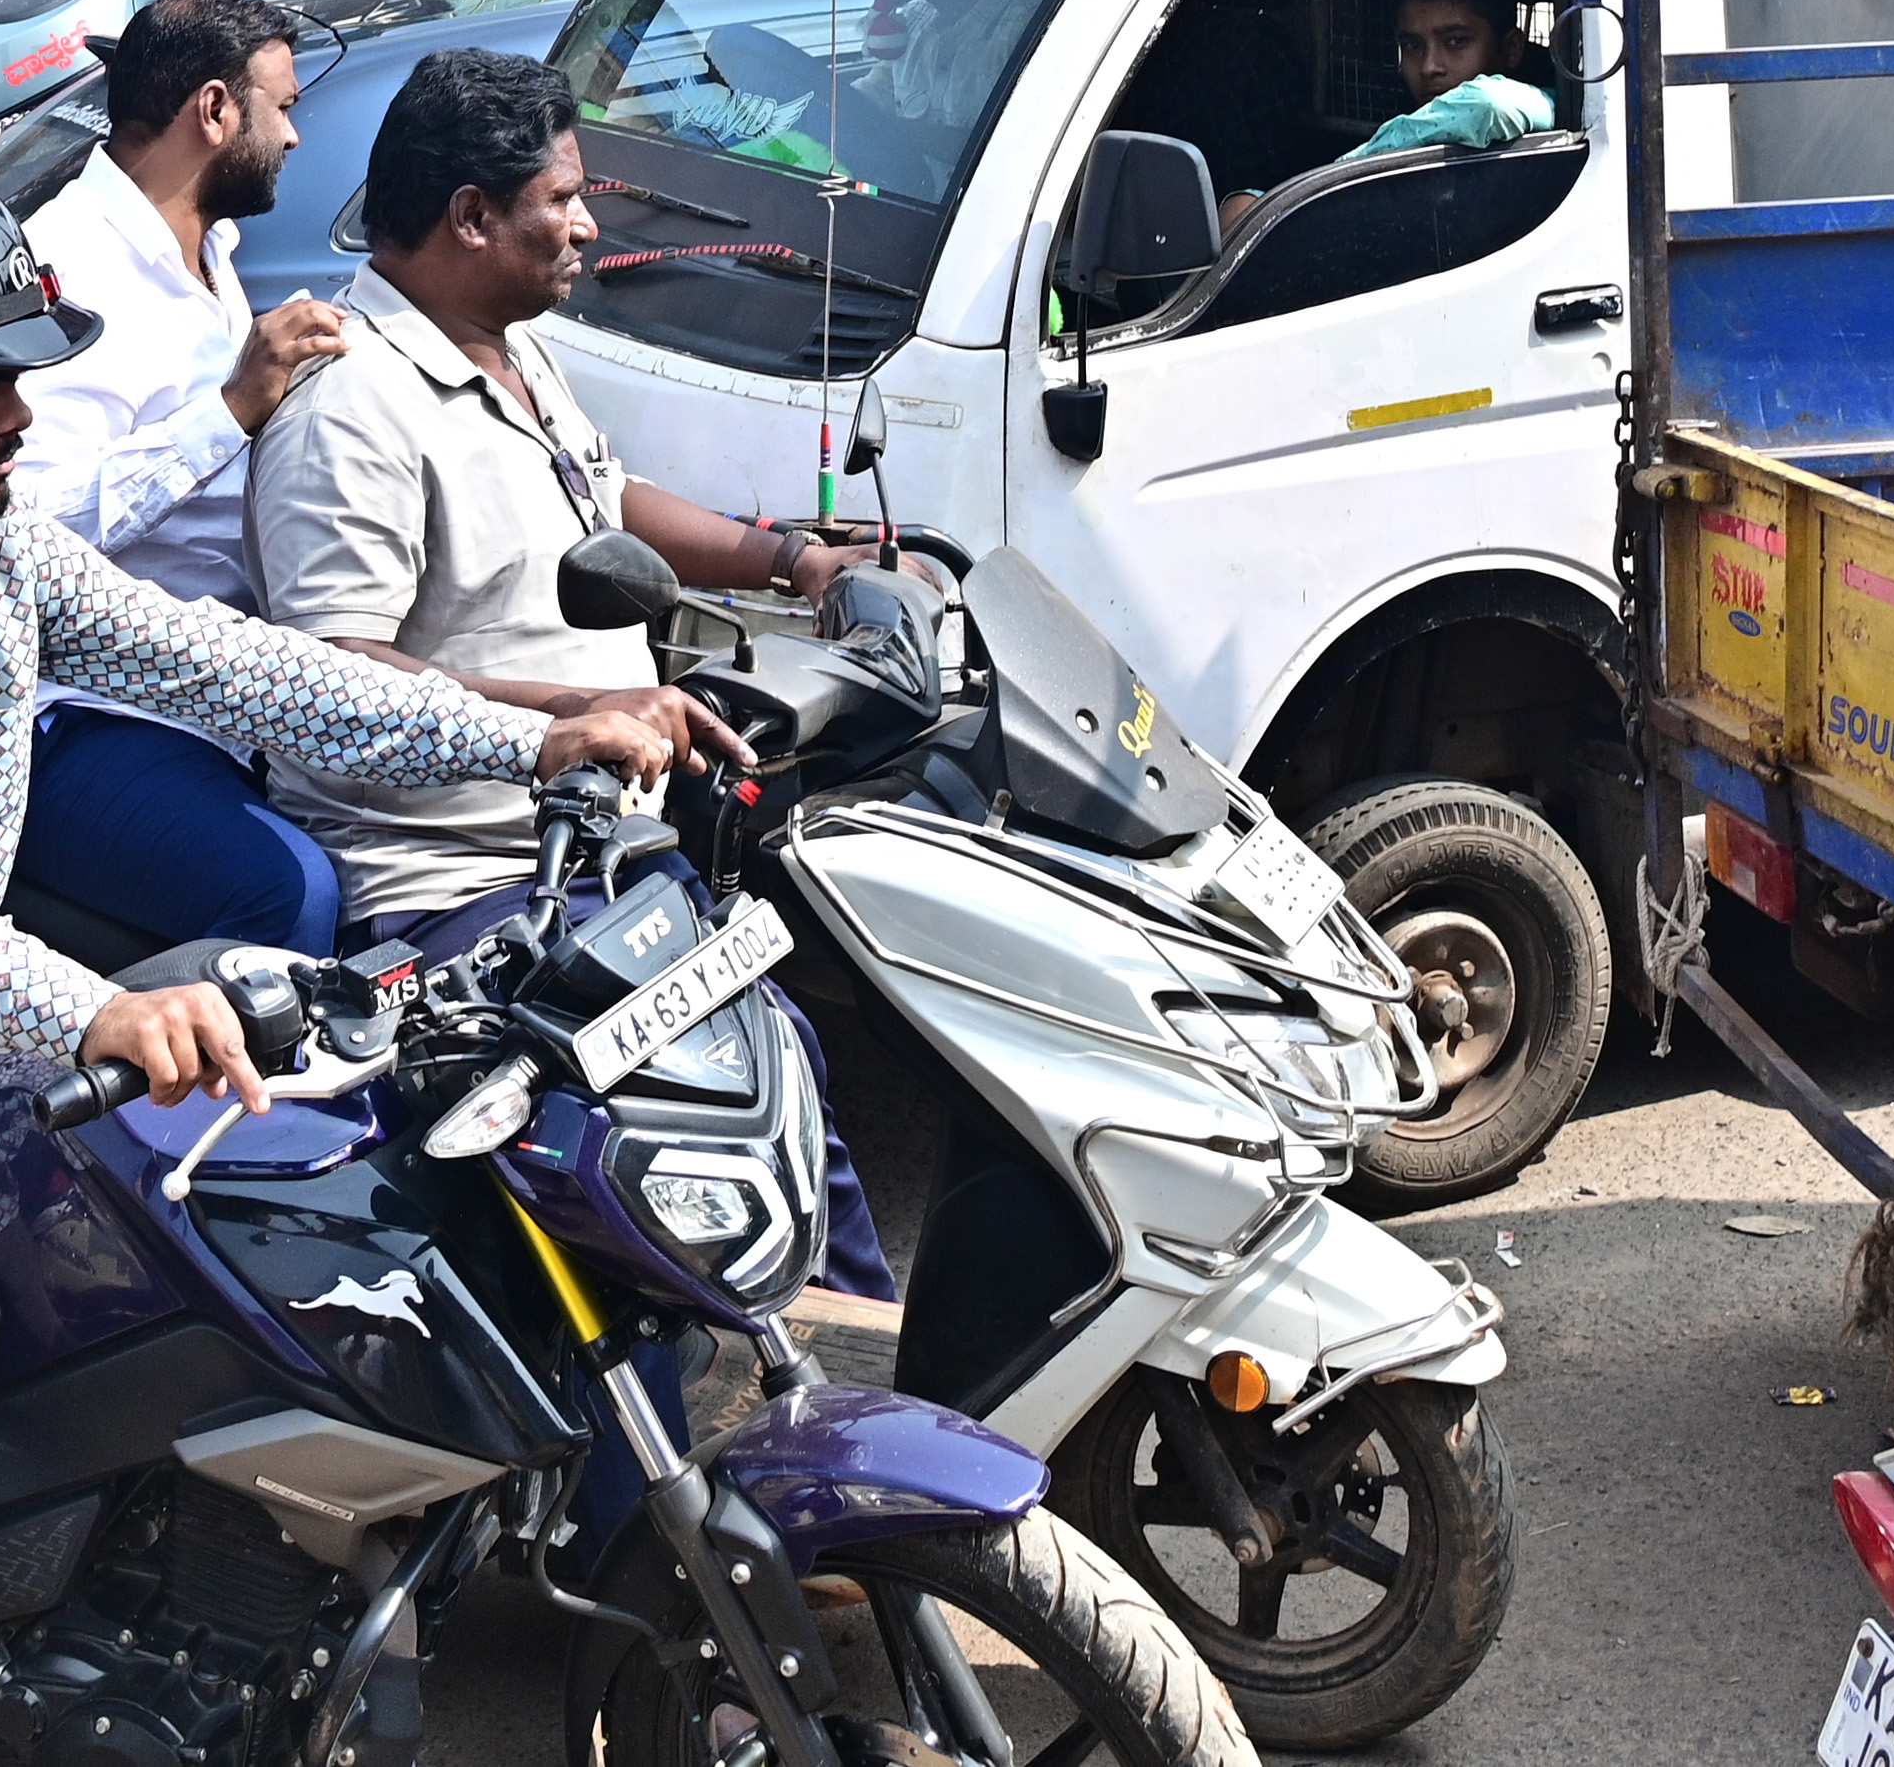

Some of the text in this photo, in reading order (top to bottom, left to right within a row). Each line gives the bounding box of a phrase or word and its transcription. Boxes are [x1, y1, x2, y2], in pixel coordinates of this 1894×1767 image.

[1712, 551, 1765, 616] STOP
[622, 906, 673, 959] TVS
[373, 973, 421, 1015] MS
[609, 915, 783, 1062] KA 63 Y 1004
[1843, 1684, 1861, 1714] IND
